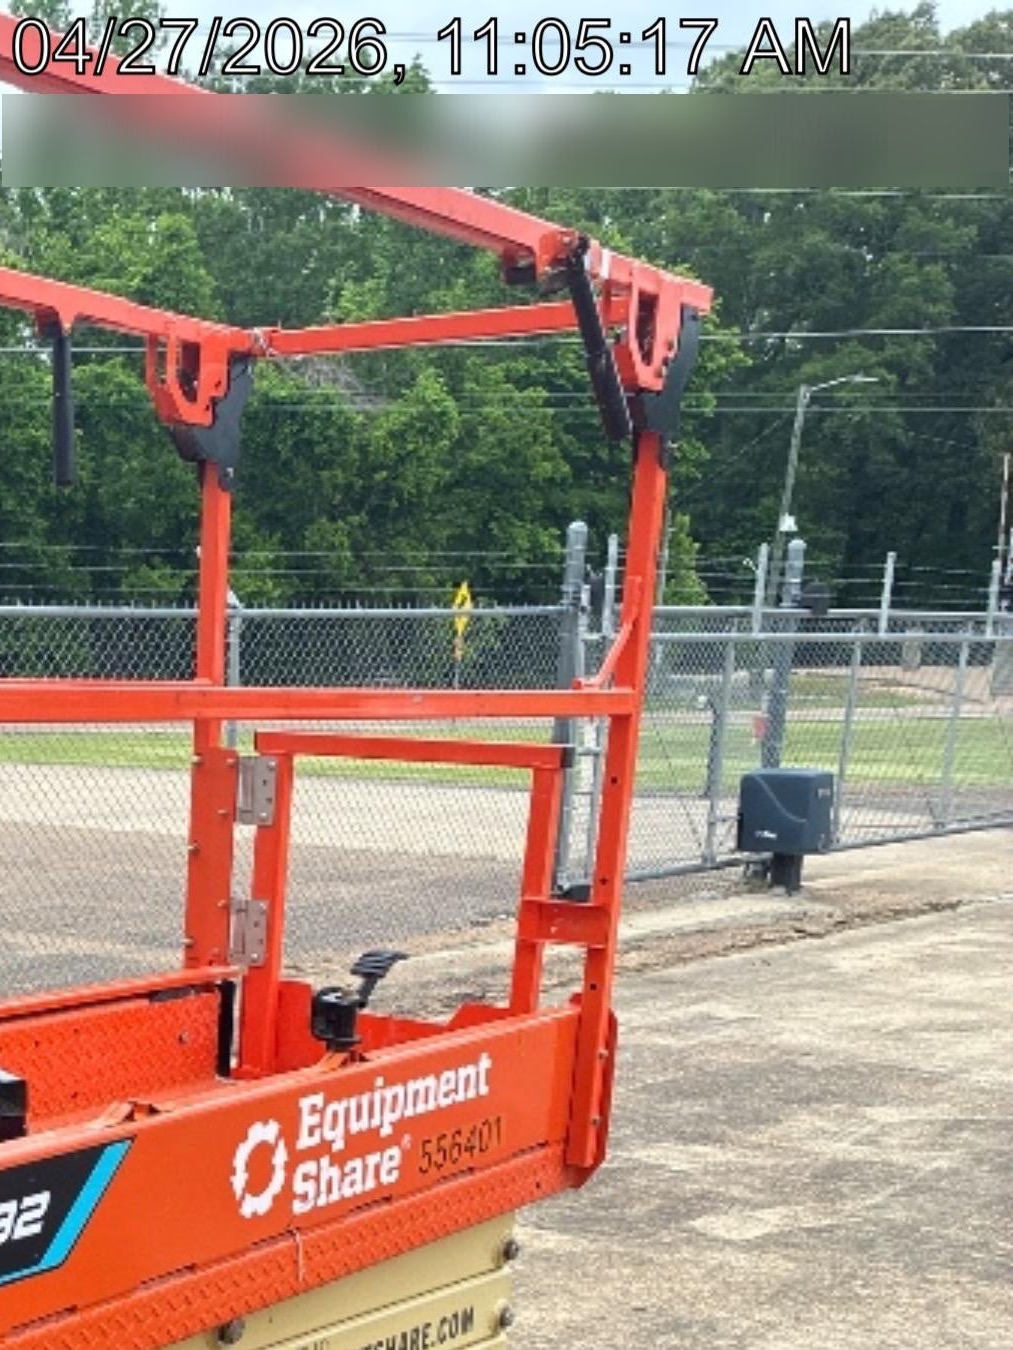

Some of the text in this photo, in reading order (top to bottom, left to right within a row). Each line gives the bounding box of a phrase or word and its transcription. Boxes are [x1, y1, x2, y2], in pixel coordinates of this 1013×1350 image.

[296, 1053, 492, 1151] Equipment
[292, 1144, 402, 1215] Share
[418, 1116, 502, 1175] 556401
